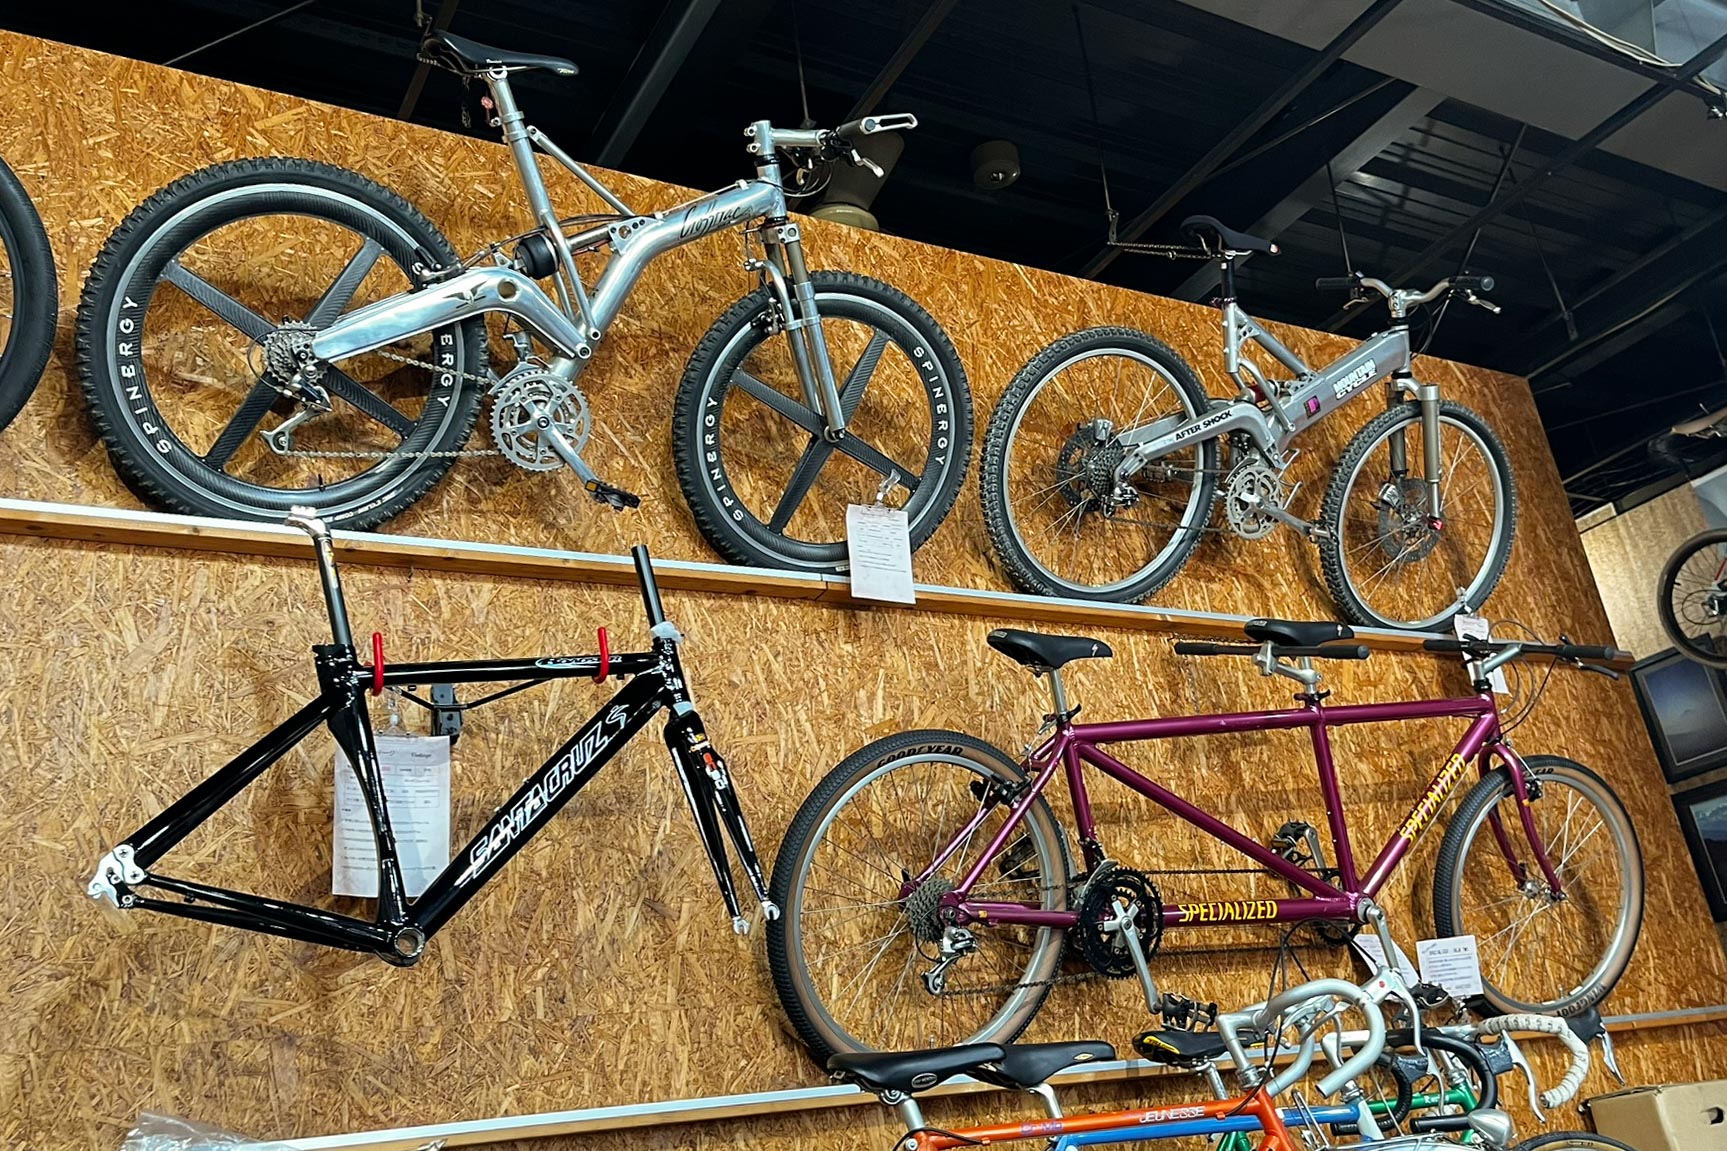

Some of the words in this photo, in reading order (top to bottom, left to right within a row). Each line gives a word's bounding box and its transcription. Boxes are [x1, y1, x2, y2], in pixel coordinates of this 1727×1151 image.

[119, 296, 172, 454] SPINERGY
[1332, 358, 1376, 393] MOUNTAIN
[913, 346, 949, 465] SPINERGY
[1175, 424, 1201, 440] AFTER
[1202, 410, 1232, 428] SHOCK
[705, 397, 744, 521] SPINERGY
[877, 744, 963, 769] GOODYEAR
[1400, 753, 1466, 842] SPECIALIZED
[1178, 899, 1278, 923] SPECIALIZED
[1139, 1105, 1206, 1124] JEUNESSE
